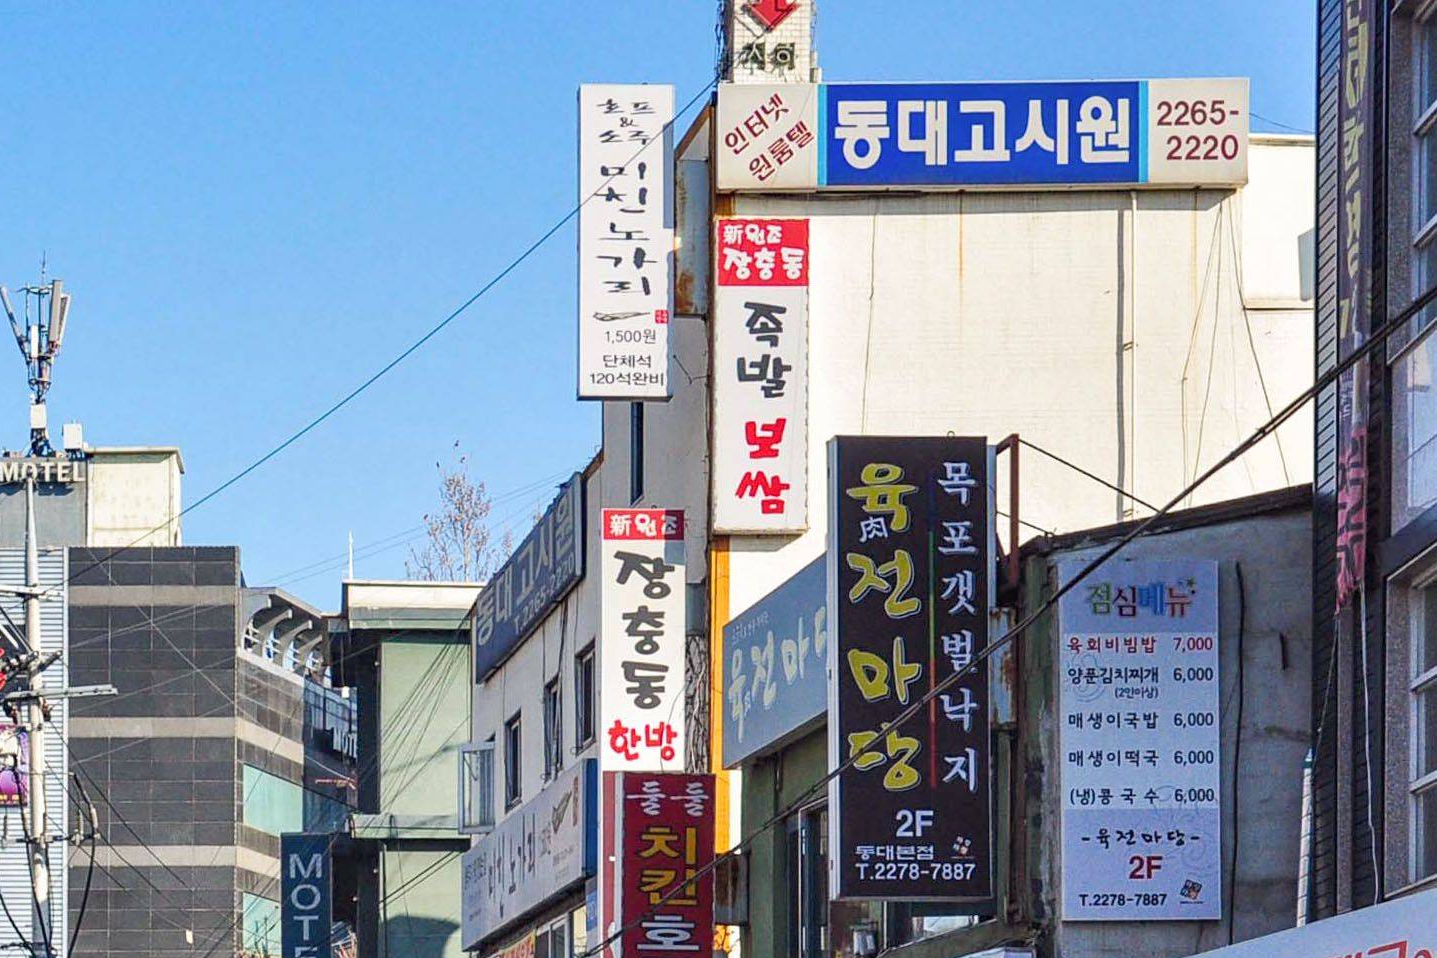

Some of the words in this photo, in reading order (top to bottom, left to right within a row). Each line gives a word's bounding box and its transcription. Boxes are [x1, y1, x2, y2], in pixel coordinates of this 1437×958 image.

[597, 100, 654, 116] 호프
[1157, 100, 1239, 126] 2265-
[725, 93, 789, 155] 인터넷
[834, 96, 1130, 169] 동대고시원
[600, 130, 650, 146] 소주
[749, 120, 816, 182] 원룸텔
[1167, 135, 1238, 161] 2220
[723, 247, 804, 280] 장충동
[604, 330, 656, 345] 1,500원
[736, 301, 791, 398] 족발
[603, 354, 651, 368] 단체석
[590, 372, 664, 386] 120석완비
[735, 418, 790, 514] 보쌈
[1086, 581, 1195, 618] 점심메뉴
[613, 550, 674, 710] 장충동
[846, 462, 922, 793] 육전마당
[937, 460, 981, 793] 목포갯벌낙지
[1066, 637, 1157, 653] 육회비빔밥
[1172, 637, 1214, 652] 7,000
[1067, 667, 1159, 684] 양푼김치찌개
[1172, 668, 1214, 683] 6,000
[1114, 686, 1159, 700] (2인이상)
[1068, 712, 1159, 730] 매생이국밥
[1173, 712, 1214, 728] 6,000
[608, 720, 677, 762] 한방
[1068, 749, 1159, 767] 매생이떡국
[1173, 750, 1214, 766] 6,000
[627, 779, 709, 816] 둘둘
[1174, 787, 1215, 804] 6,000
[896, 809, 934, 838] 2F
[635, 823, 699, 908] 치킨
[855, 844, 935, 861] 동대본점
[855, 862, 976, 881] T.2278-7887
[1128, 855, 1163, 880] 2F
[1079, 892, 1168, 908] T.2278-7887
